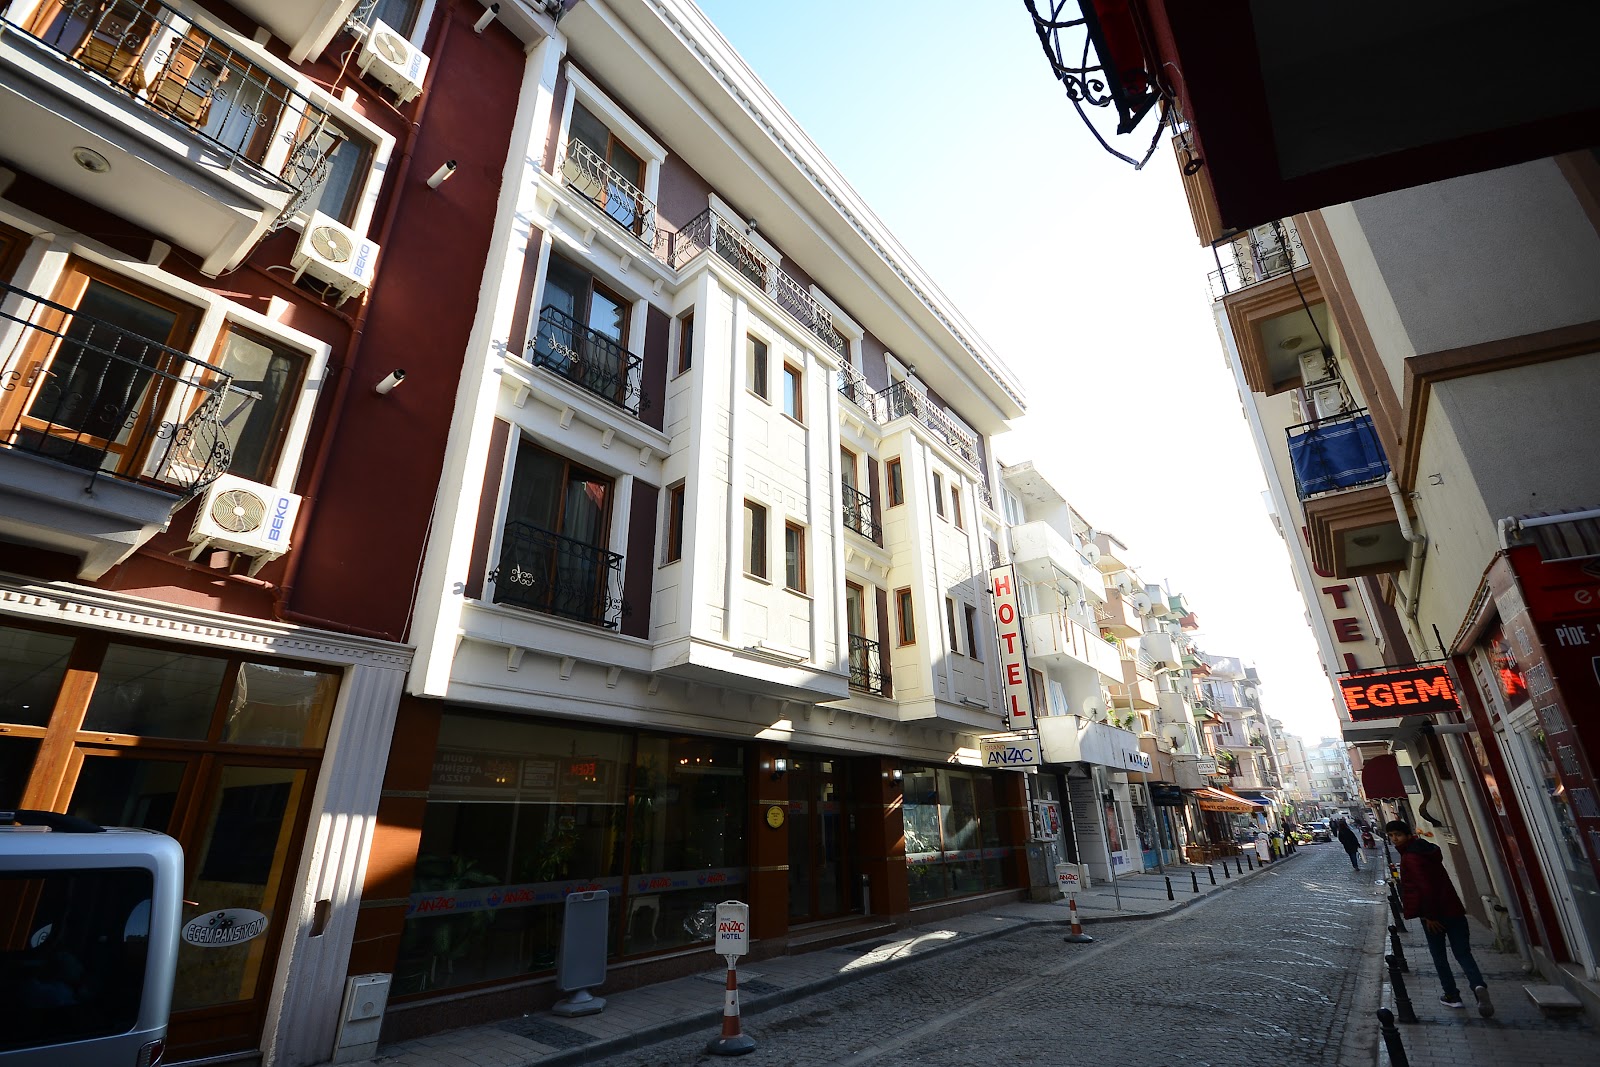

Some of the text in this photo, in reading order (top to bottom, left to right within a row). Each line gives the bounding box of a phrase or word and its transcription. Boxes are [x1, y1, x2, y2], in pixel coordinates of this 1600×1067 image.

[409, 53, 422, 80] BEKO
[353, 244, 370, 277] BEKO
[268, 497, 290, 541] BEKO
[994, 575, 1027, 717] HOTEL
[1555, 624, 1590, 647] PİDE
[1343, 676, 1453, 711] EGEM
[987, 747, 1033, 765] ANZAC
[416, 896, 456, 912] ANZAC
[187, 924, 214, 943] EGEM
[718, 920, 746, 933] ANZAC
